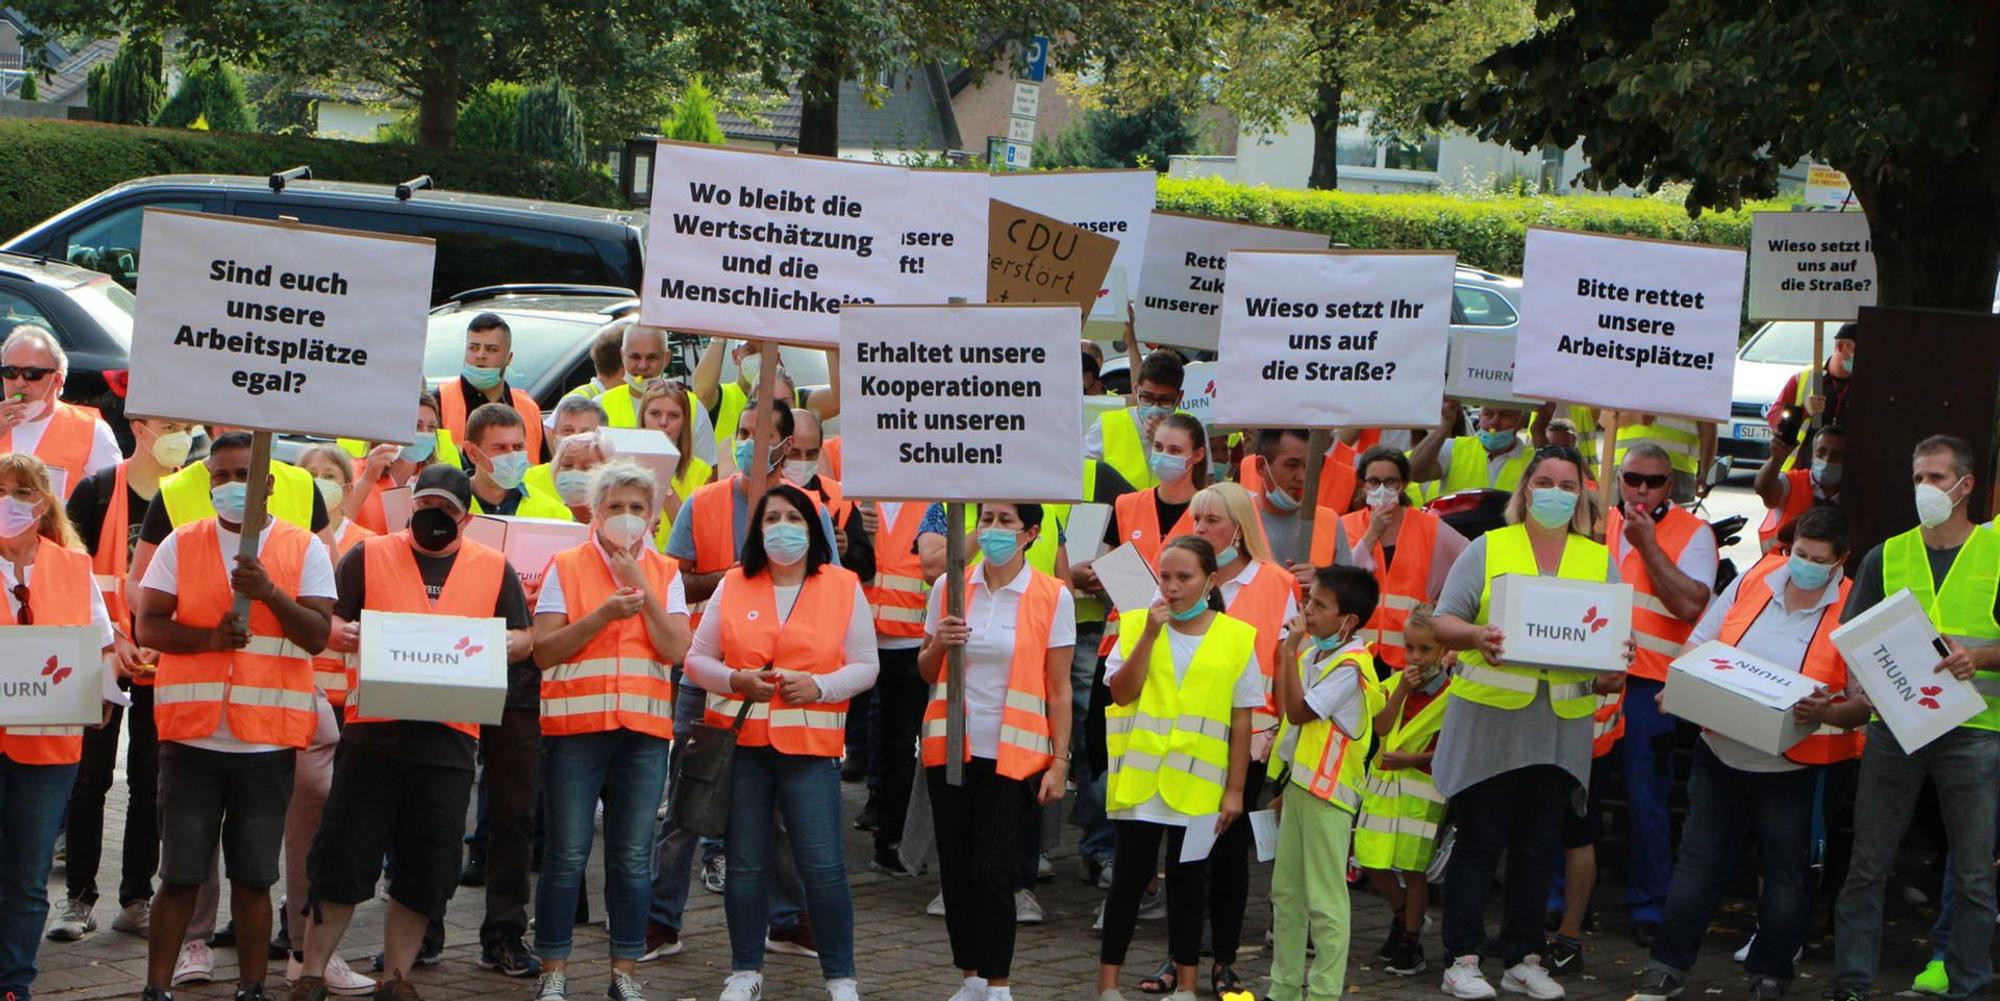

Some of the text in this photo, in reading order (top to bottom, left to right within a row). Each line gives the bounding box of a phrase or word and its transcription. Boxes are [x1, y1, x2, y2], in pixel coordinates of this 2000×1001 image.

[690, 182, 861, 218] Wo bleibt die
[674, 214, 873, 257] Wertschätzung
[1072, 221, 1127, 232] nsere
[901, 232, 954, 246] sere
[1008, 219, 1078, 261] CDU
[1768, 239, 1870, 253] Wieso setzt I
[723, 251, 818, 279] und die
[899, 255, 924, 274] ft!
[1184, 251, 1227, 270] Rett
[1797, 259, 1858, 273] uns auf
[210, 260, 347, 295] Sind euch
[988, 254, 1075, 294] erstört
[1189, 276, 1225, 293] Zuk
[1781, 277, 1872, 292] die Straße?
[1577, 277, 1704, 310] Bitte rettet
[227, 301, 325, 327] unsere
[1144, 296, 1219, 315] unserer
[1246, 298, 1423, 319] Wieso setzt Ihr
[1598, 313, 1675, 336] unsere
[174, 325, 367, 366] Arbeitsplätze
[1289, 330, 1378, 350] uns auf
[857, 341, 1046, 364] Erhaltet unsere
[1558, 334, 1715, 371] Arbeitsplätze!
[1262, 360, 1396, 381] die Straße?
[1467, 368, 1513, 382] THURN
[232, 371, 306, 395] egal?
[861, 374, 1042, 402] Kooperationen
[1179, 397, 1209, 410] URN
[877, 408, 1026, 431] mit unseren
[1742, 427, 1755, 438] SU
[899, 441, 1003, 465] Schulen!
[1525, 622, 1586, 643] THURN
[389, 649, 459, 665] THURN
[1735, 660, 1792, 687] THURN
[1873, 644, 1917, 702] THURN
[0, 681, 47, 698] URN
